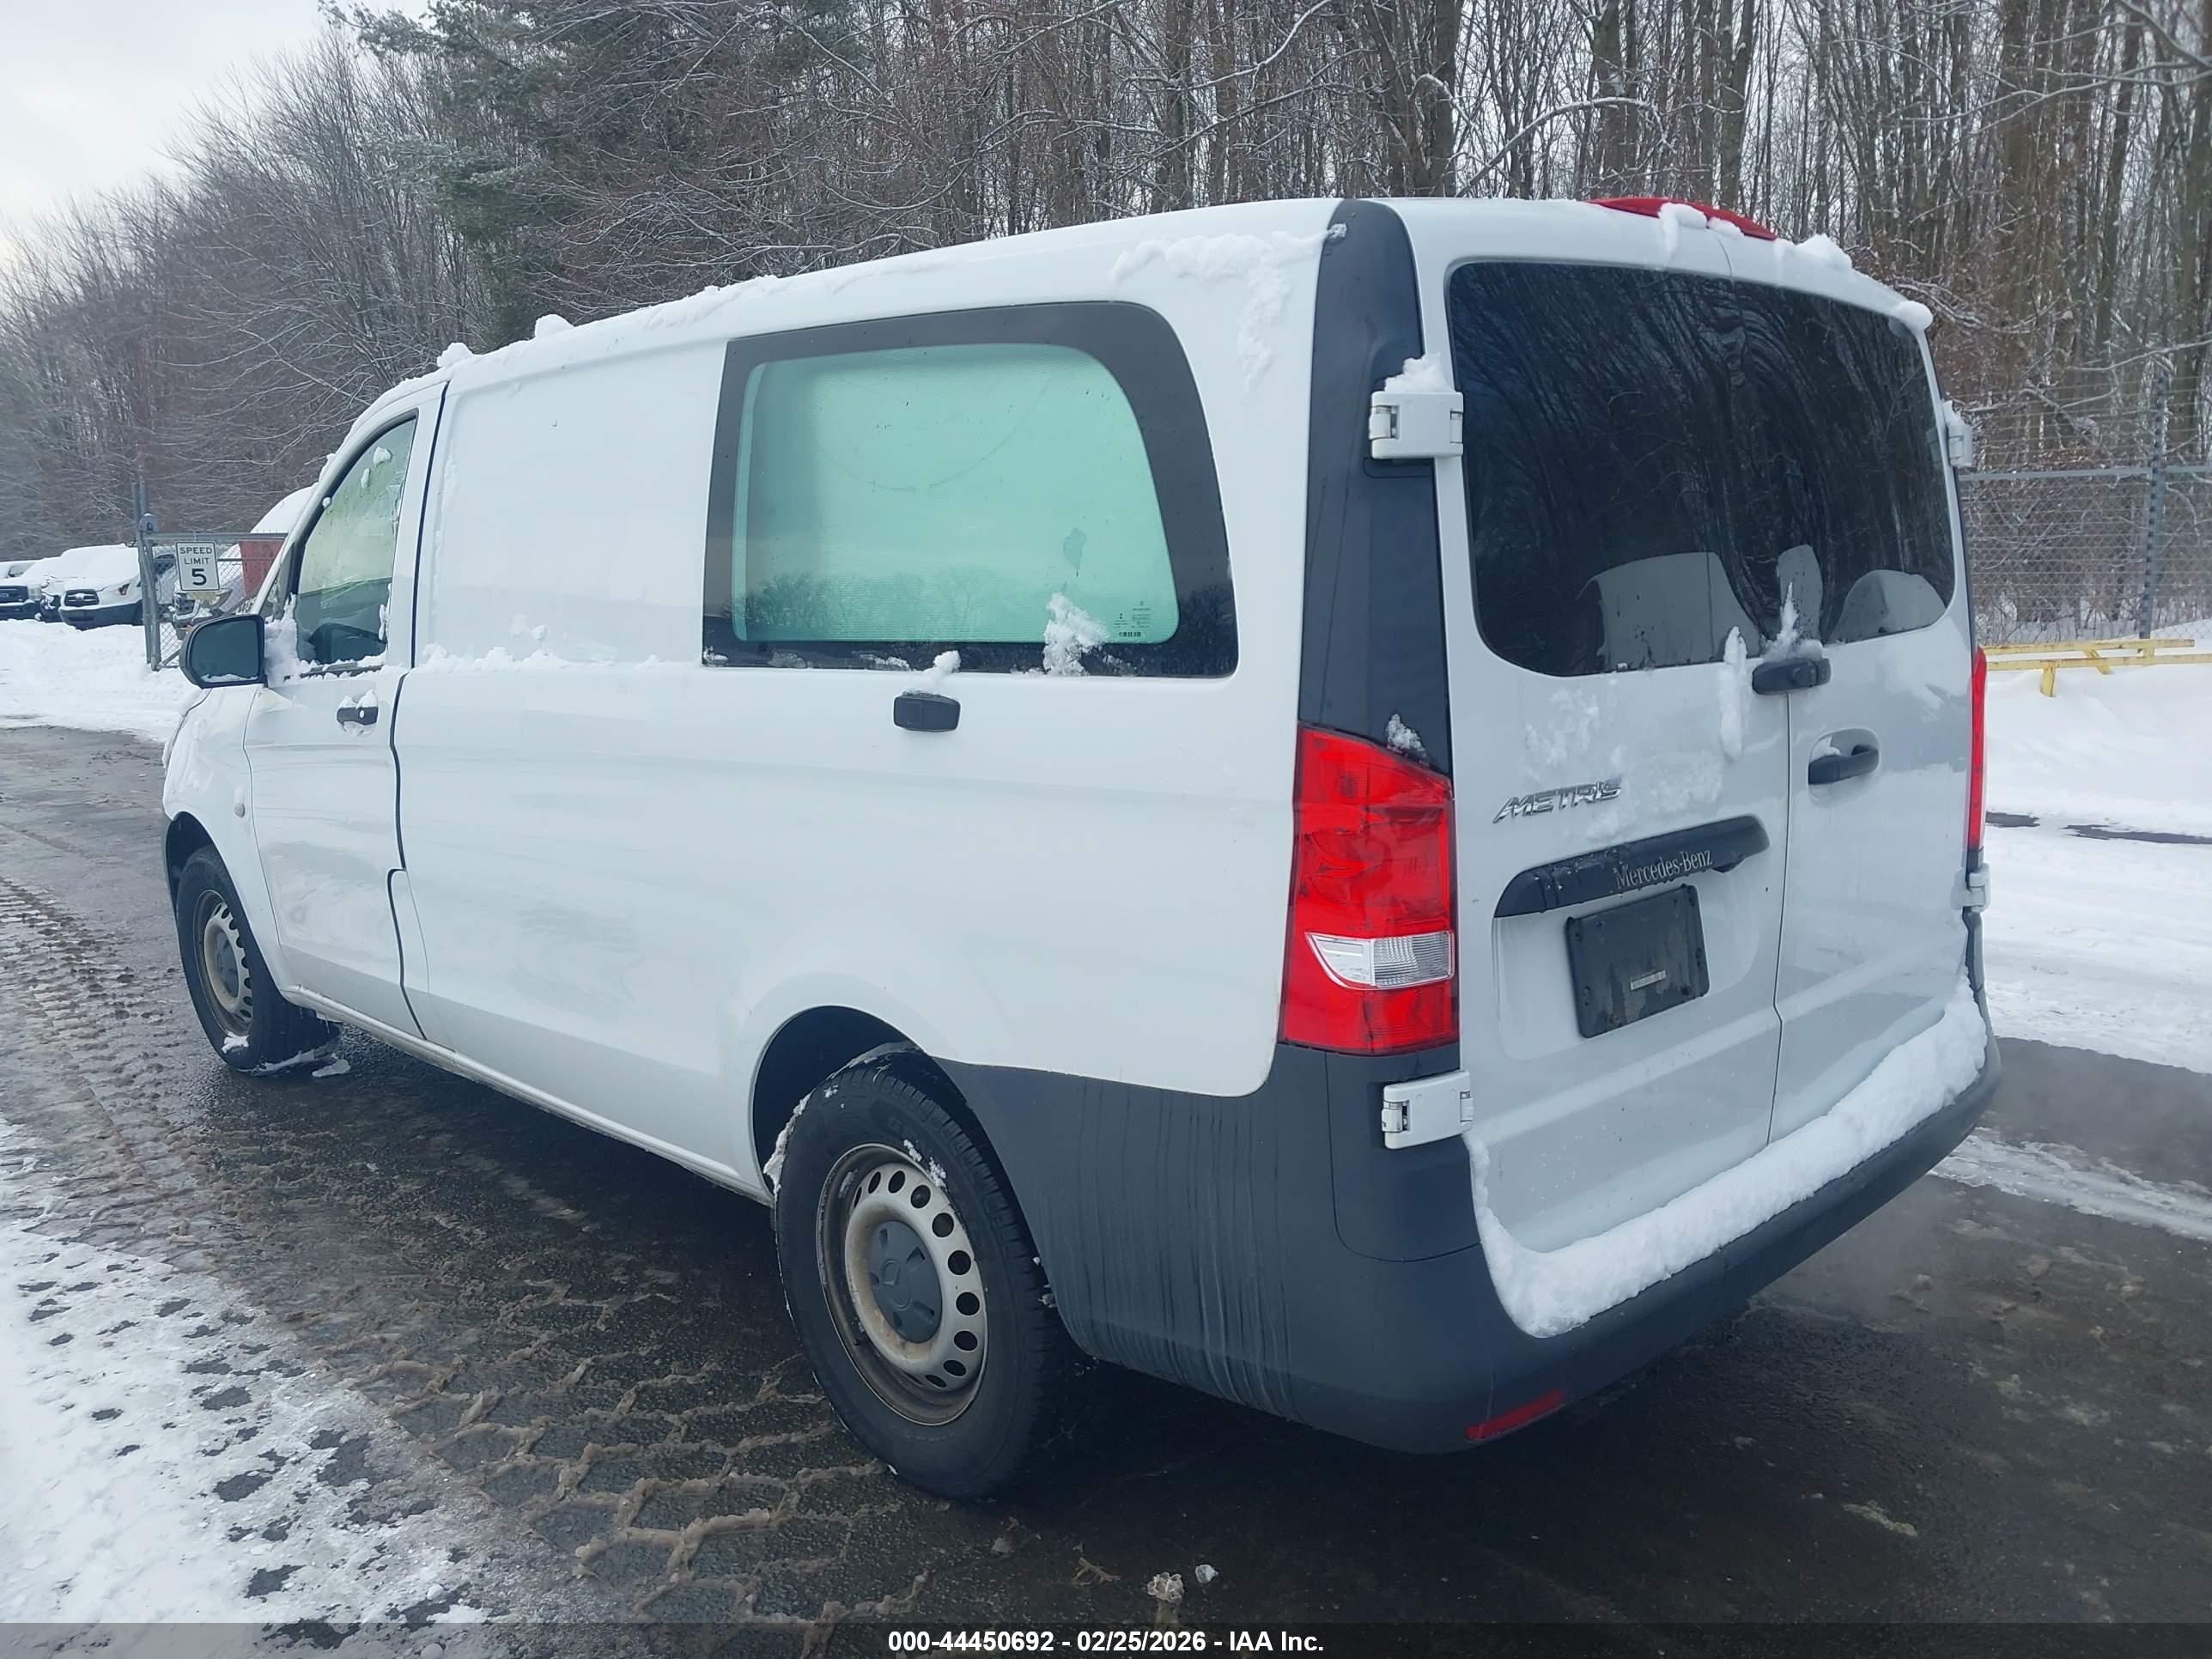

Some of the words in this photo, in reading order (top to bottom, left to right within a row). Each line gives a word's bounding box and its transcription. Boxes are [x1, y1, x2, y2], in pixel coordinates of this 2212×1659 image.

[179, 546, 212, 555] SPEED
[191, 568, 207, 586] 5
[1492, 781, 1622, 823] METRIS
[1613, 850, 1713, 890] Mercedes-Benz
